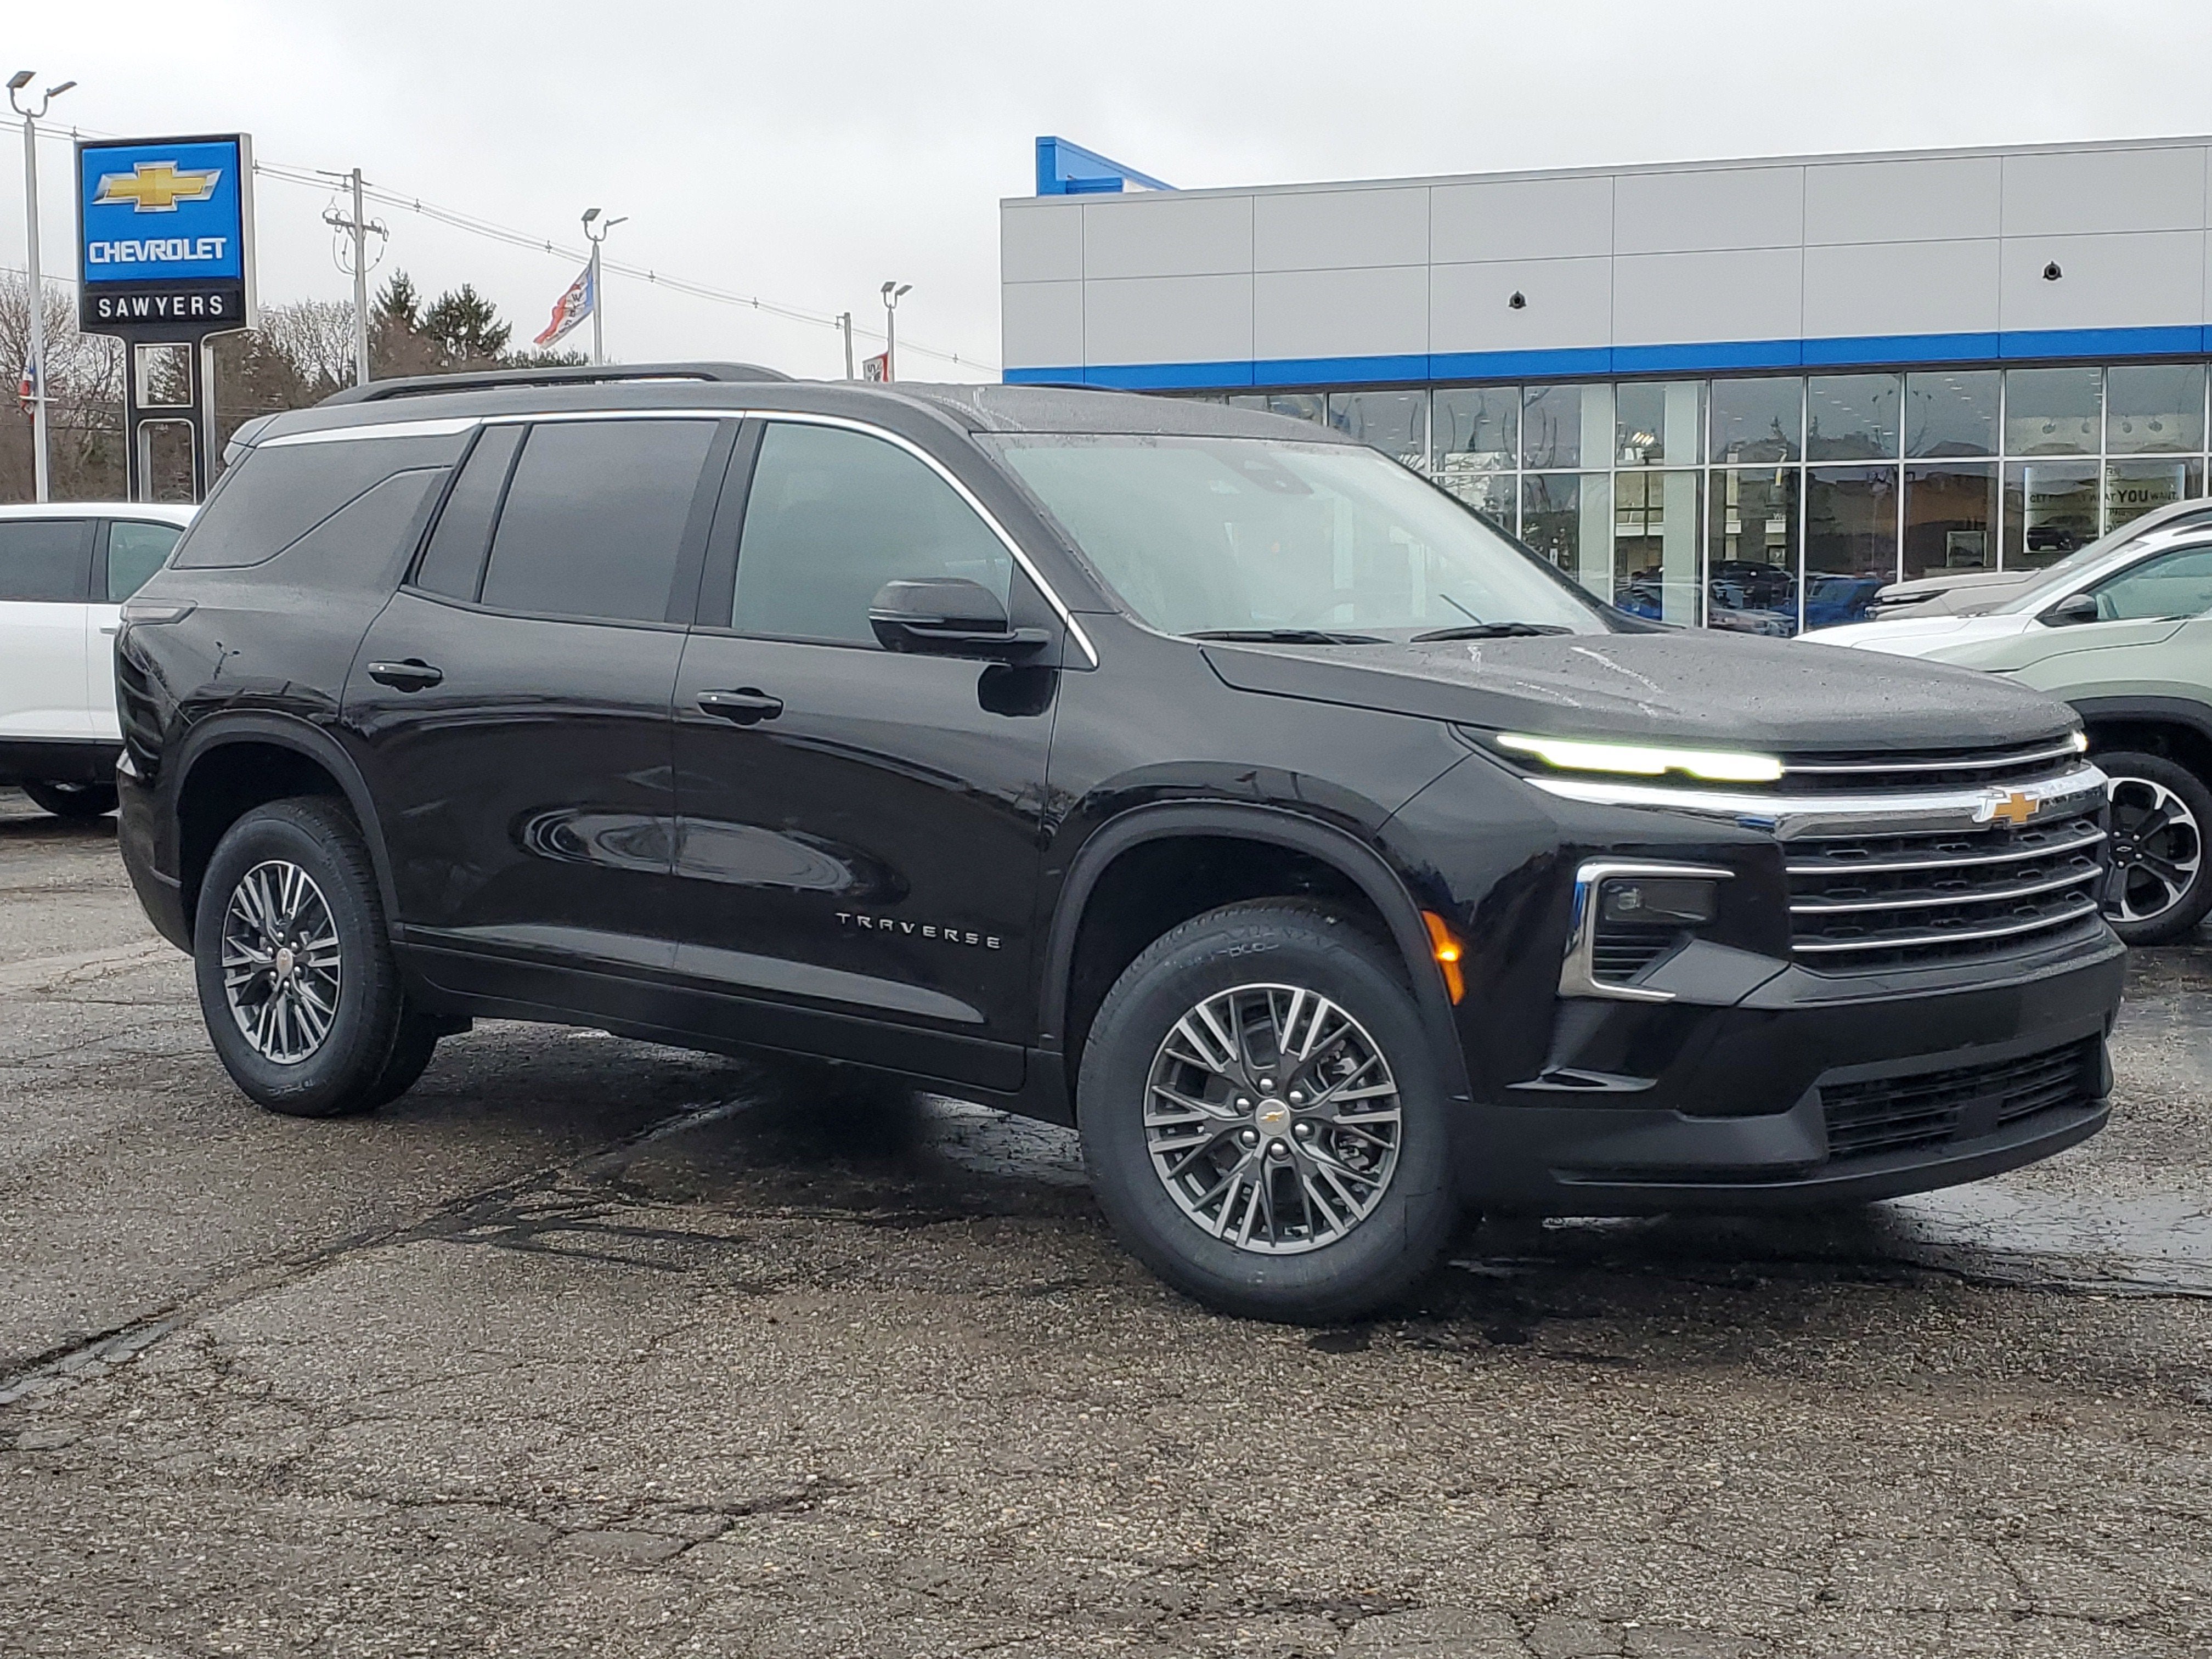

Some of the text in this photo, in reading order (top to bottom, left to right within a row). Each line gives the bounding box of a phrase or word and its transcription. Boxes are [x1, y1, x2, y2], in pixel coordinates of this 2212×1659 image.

[89, 238, 227, 263] CHEVROLET
[98, 295, 223, 318] SAWYERS
[2117, 489, 2149, 503] YOU
[835, 912, 1002, 949] TRAVERSE
